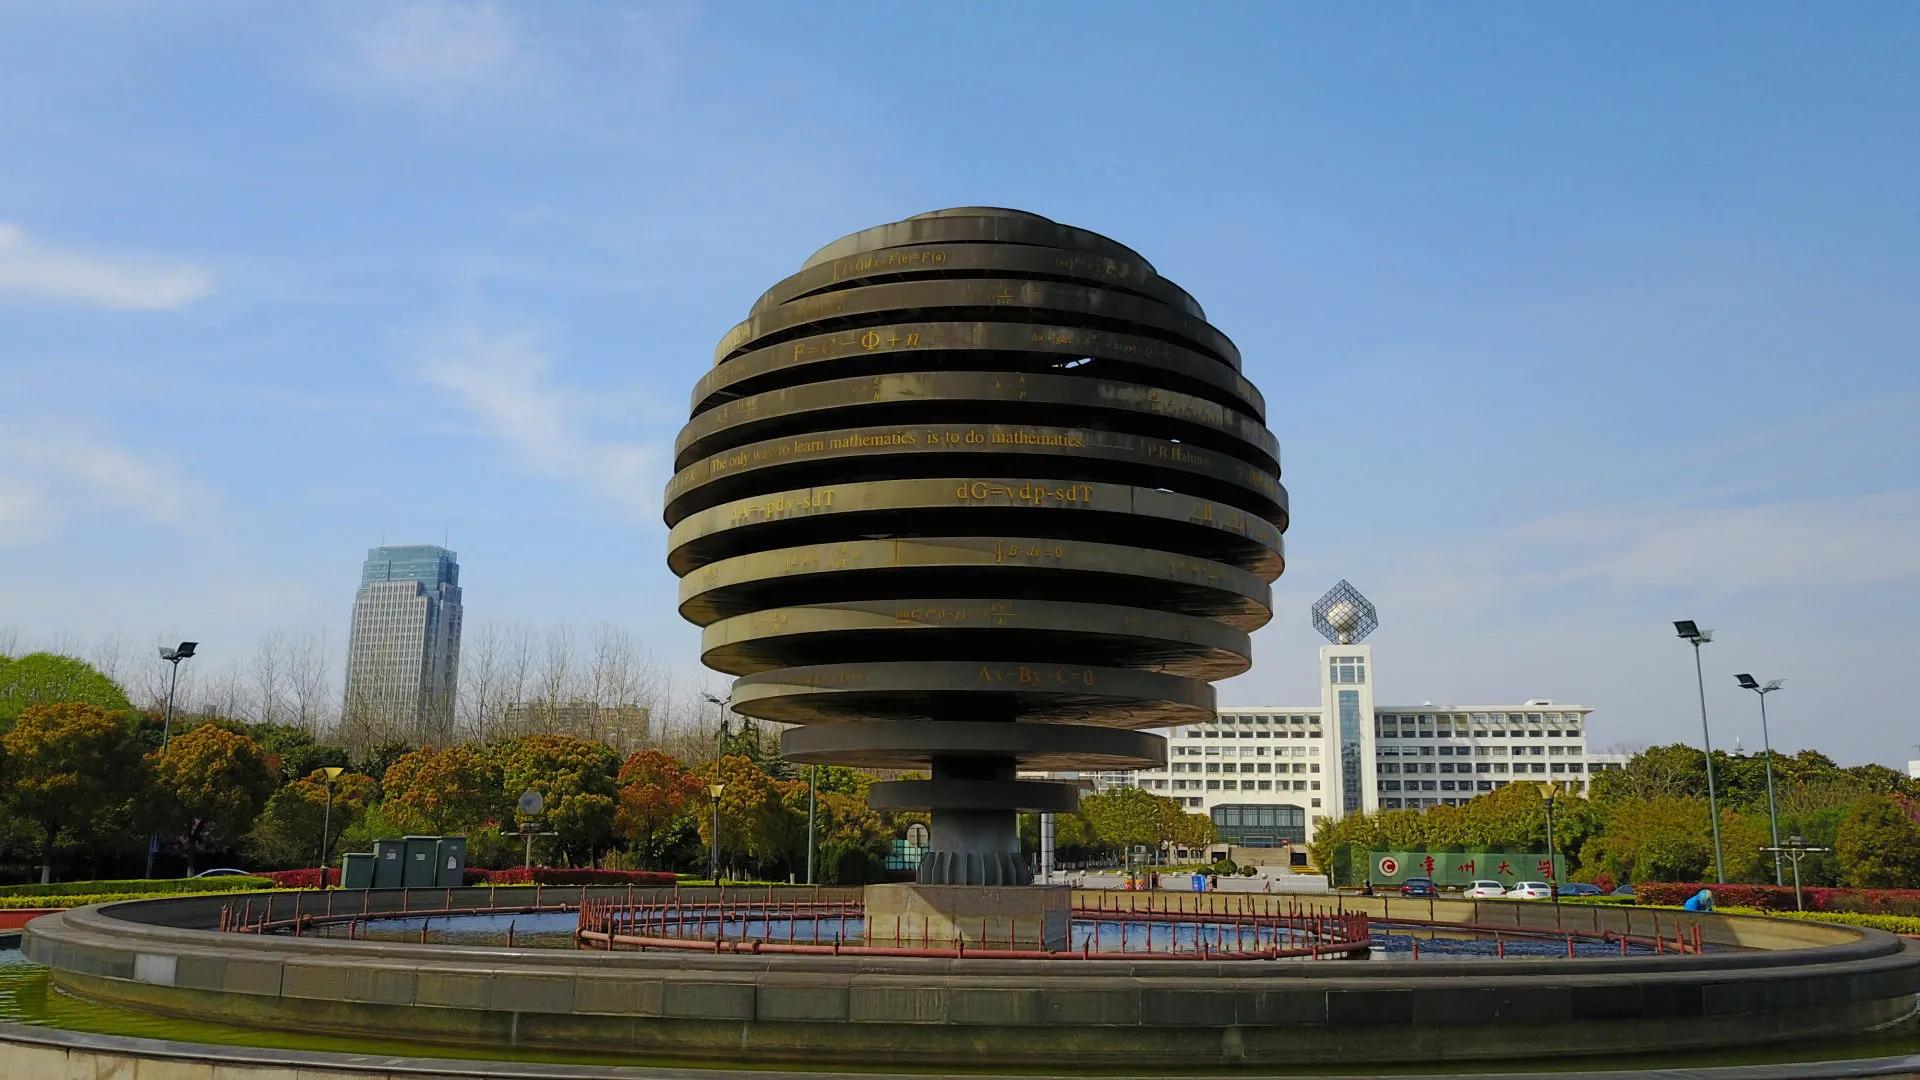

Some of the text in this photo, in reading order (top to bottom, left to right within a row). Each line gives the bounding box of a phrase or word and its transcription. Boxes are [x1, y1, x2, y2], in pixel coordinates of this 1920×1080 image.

[712, 459, 727, 472] The
[729, 453, 749, 467] only
[778, 445, 790, 456] to
[794, 440, 824, 453] learn
[829, 431, 916, 450] mathematics
[928, 430, 938, 444] is
[945, 431, 960, 444] to
[965, 430, 984, 444] do
